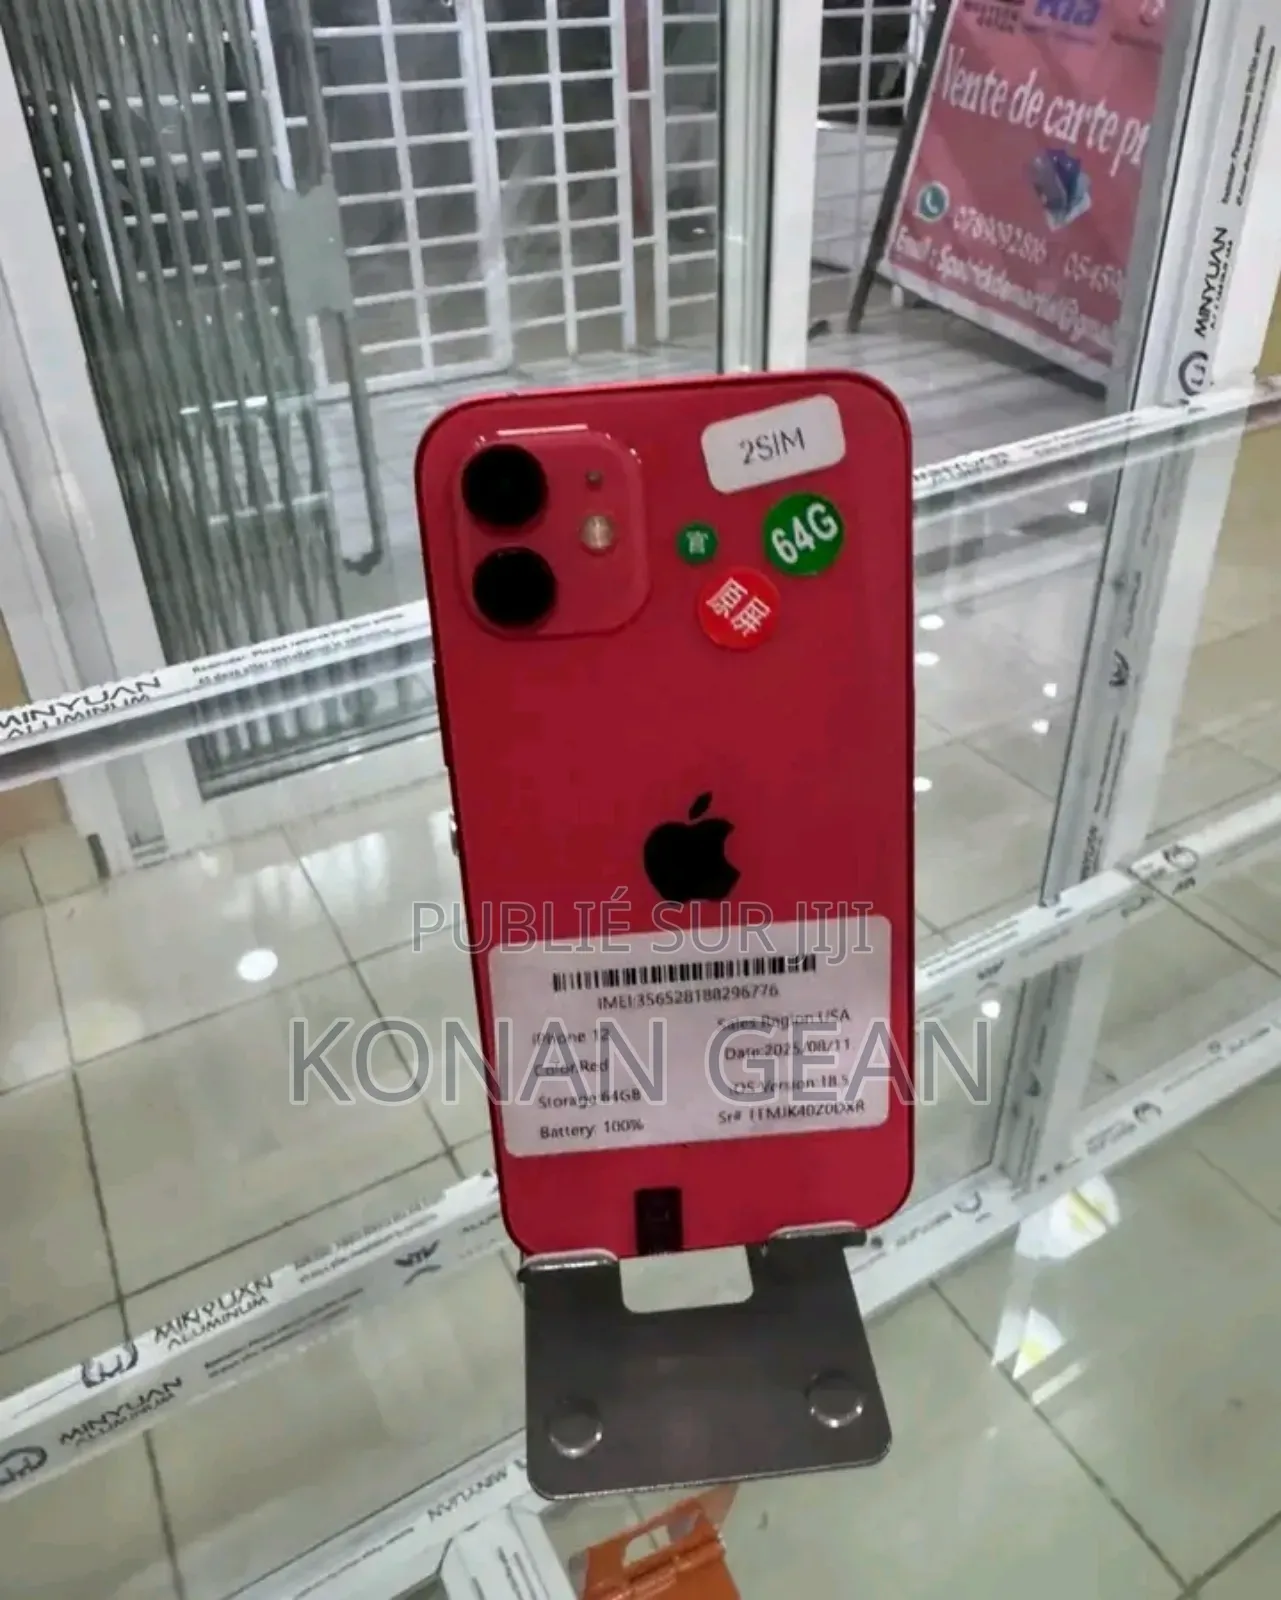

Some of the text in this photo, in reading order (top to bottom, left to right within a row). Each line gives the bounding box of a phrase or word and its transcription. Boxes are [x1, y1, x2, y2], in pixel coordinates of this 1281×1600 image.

[942, 44, 1008, 119] Vente
[1008, 68, 1045, 129] de
[1043, 96, 1118, 153] carte
[1194, 226, 1229, 340] MINYUAN
[738, 426, 806, 465] 2SIM
[770, 502, 839, 564] 64G
[0, 676, 161, 728] MINYUAN
[531, 1027, 611, 1046] iPhone 12
[604, 1117, 645, 1134] 100%
[59, 1376, 182, 1446] MINYUAN
